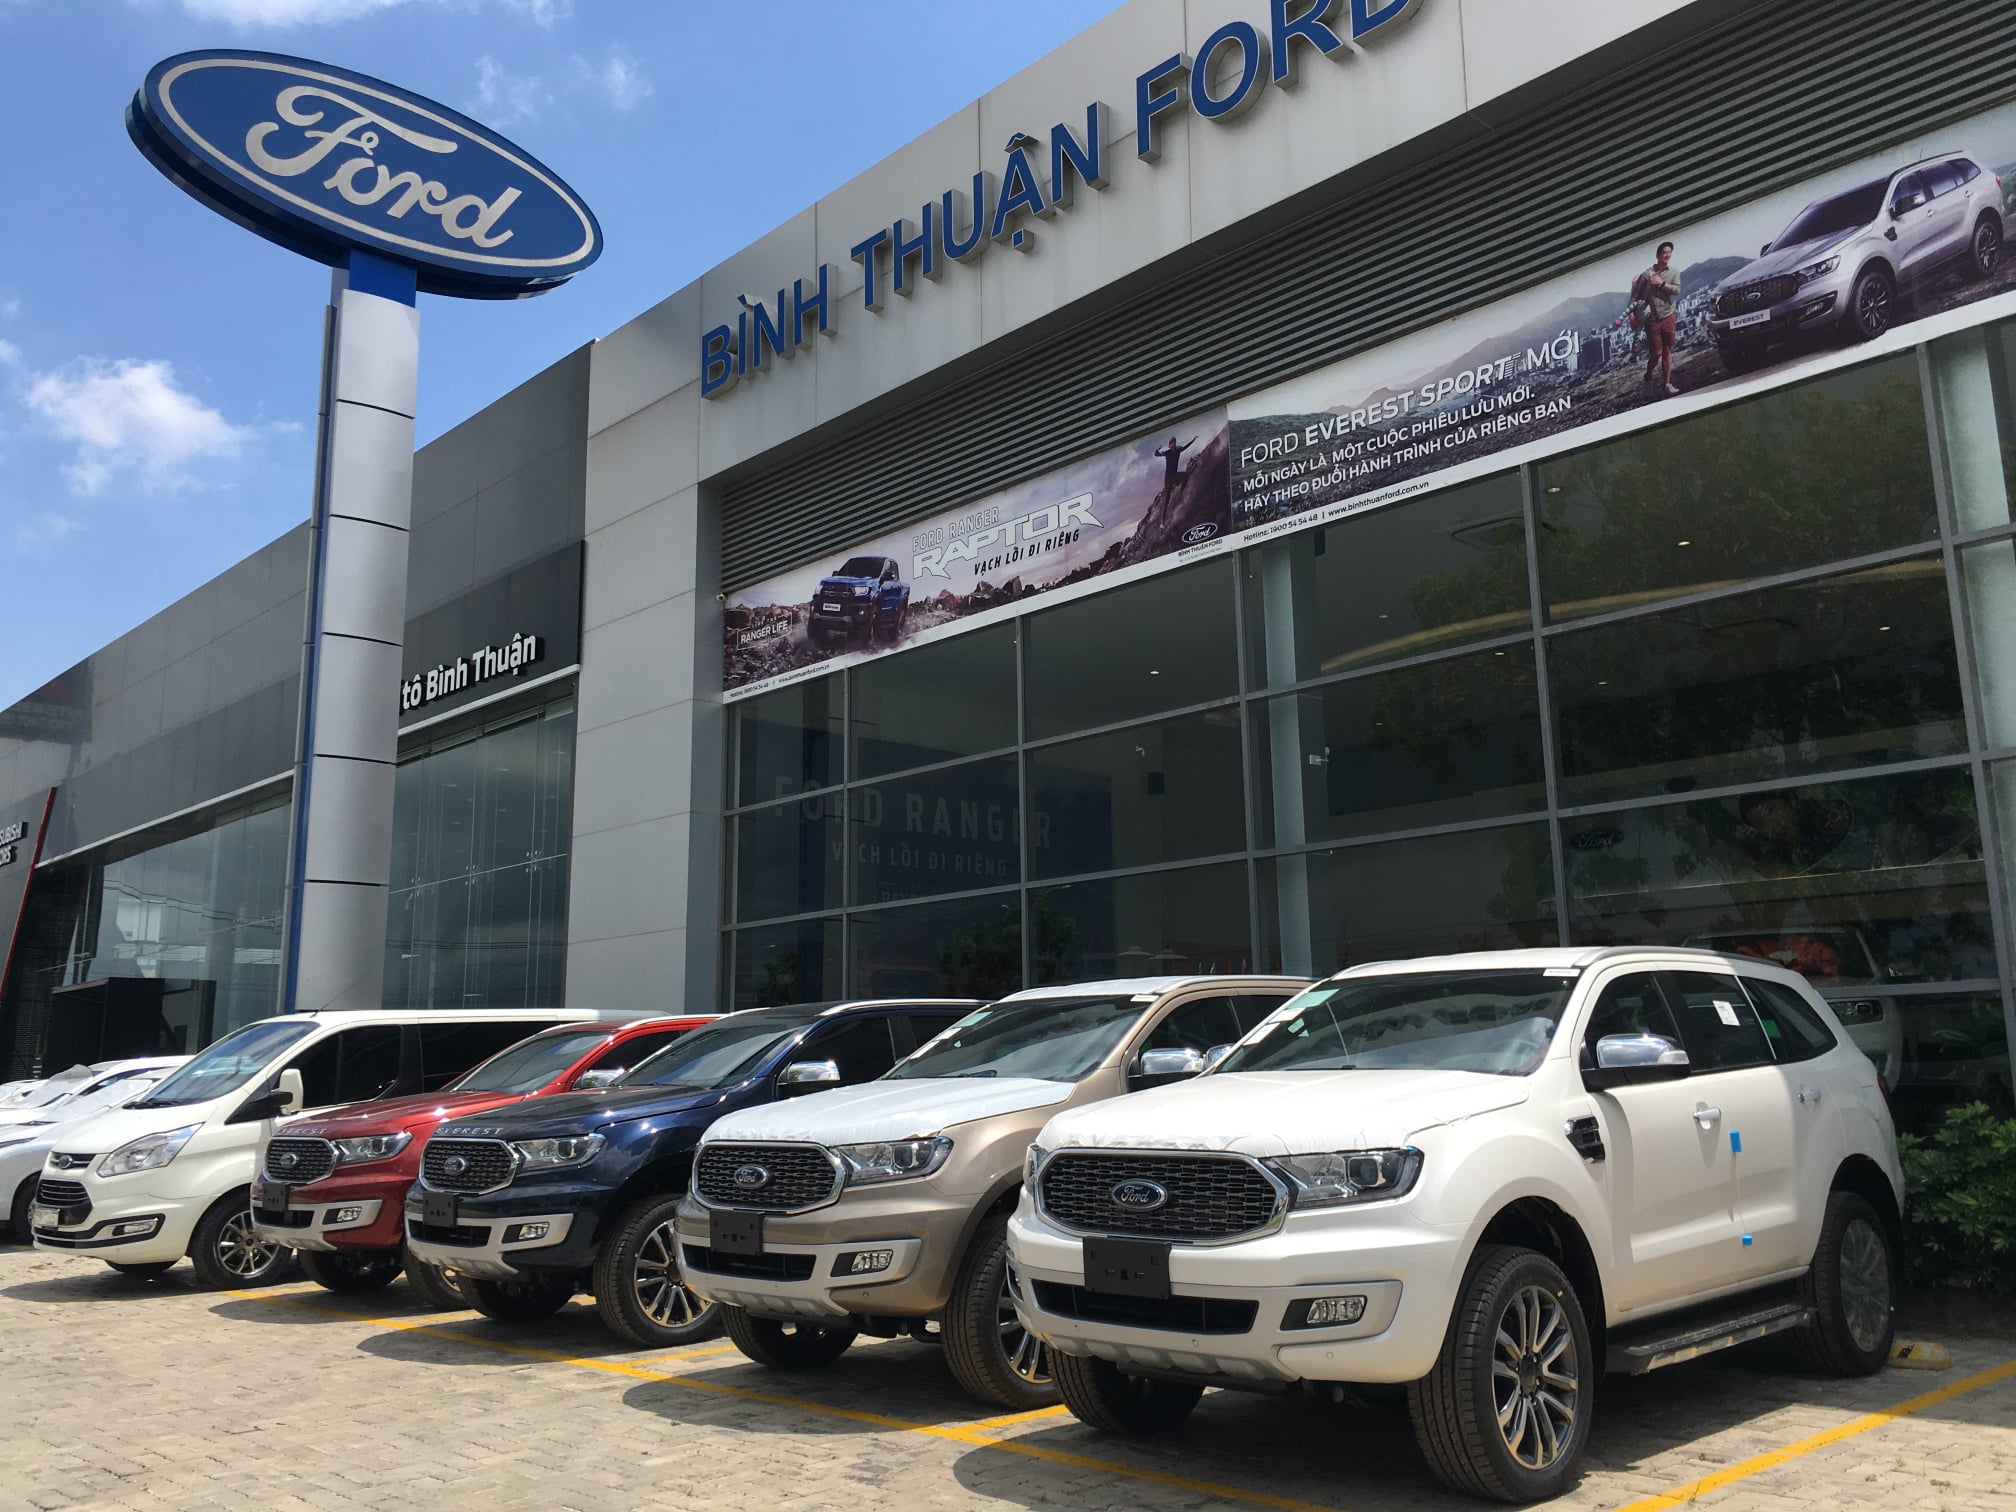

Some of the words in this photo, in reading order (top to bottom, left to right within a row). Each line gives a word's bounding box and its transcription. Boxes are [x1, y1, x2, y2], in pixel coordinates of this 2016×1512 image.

[245, 85, 521, 248] Ford
[701, 263, 832, 399] BÌNH
[850, 101, 1103, 311] THUẬN
[1733, 313, 1765, 327] EVEREST
[1241, 432, 1299, 469] FORD
[1305, 390, 1415, 447] EVEREST
[1419, 353, 1519, 408] SPORT
[1526, 329, 1581, 370] MỚI
[1243, 470, 1269, 493] MỖI
[1271, 459, 1307, 483] NGÀY
[1310, 452, 1328, 471] LÀ
[1332, 441, 1365, 464] MỘT
[1366, 427, 1409, 451] CUỘC
[1411, 411, 1459, 437] PHIÊU
[1462, 398, 1495, 421] LƯU
[1243, 492, 1272, 513] HÃY
[1272, 481, 1310, 504] THEO
[1311, 465, 1346, 491] ĐUỔI
[1349, 454, 1392, 482] HÀNH
[1393, 439, 1441, 465] TRÌNH
[1443, 427, 1477, 449] CỦA
[1480, 409, 1532, 437] RIÊNG
[1534, 395, 1572, 420] BẠN
[912, 527, 944, 553] FORD
[949, 506, 1000, 540] RANGER
[912, 491, 1105, 581] RAPTOR
[1270, 523, 1288, 534] 1900
[1288, 520, 1298, 529] 54
[1298, 516, 1308, 526] 54
[1308, 513, 1319, 523] 48
[1328, 480, 1430, 518] www.binhthuanford.com.vn
[974, 555, 1001, 577] VẠCH
[1028, 542, 1041, 558] ĐI
[1044, 527, 1081, 552] RIÊNG
[740, 626, 772, 645] RANGER
[772, 620, 788, 634] LIFE
[402, 673, 423, 710] tô
[425, 656, 468, 701] Bình
[472, 632, 537, 682] Thuận
[831, 840, 881, 865] VCH
[955, 851, 1007, 877] RIÊNG
[436, 1127, 504, 1135] EVEREST
